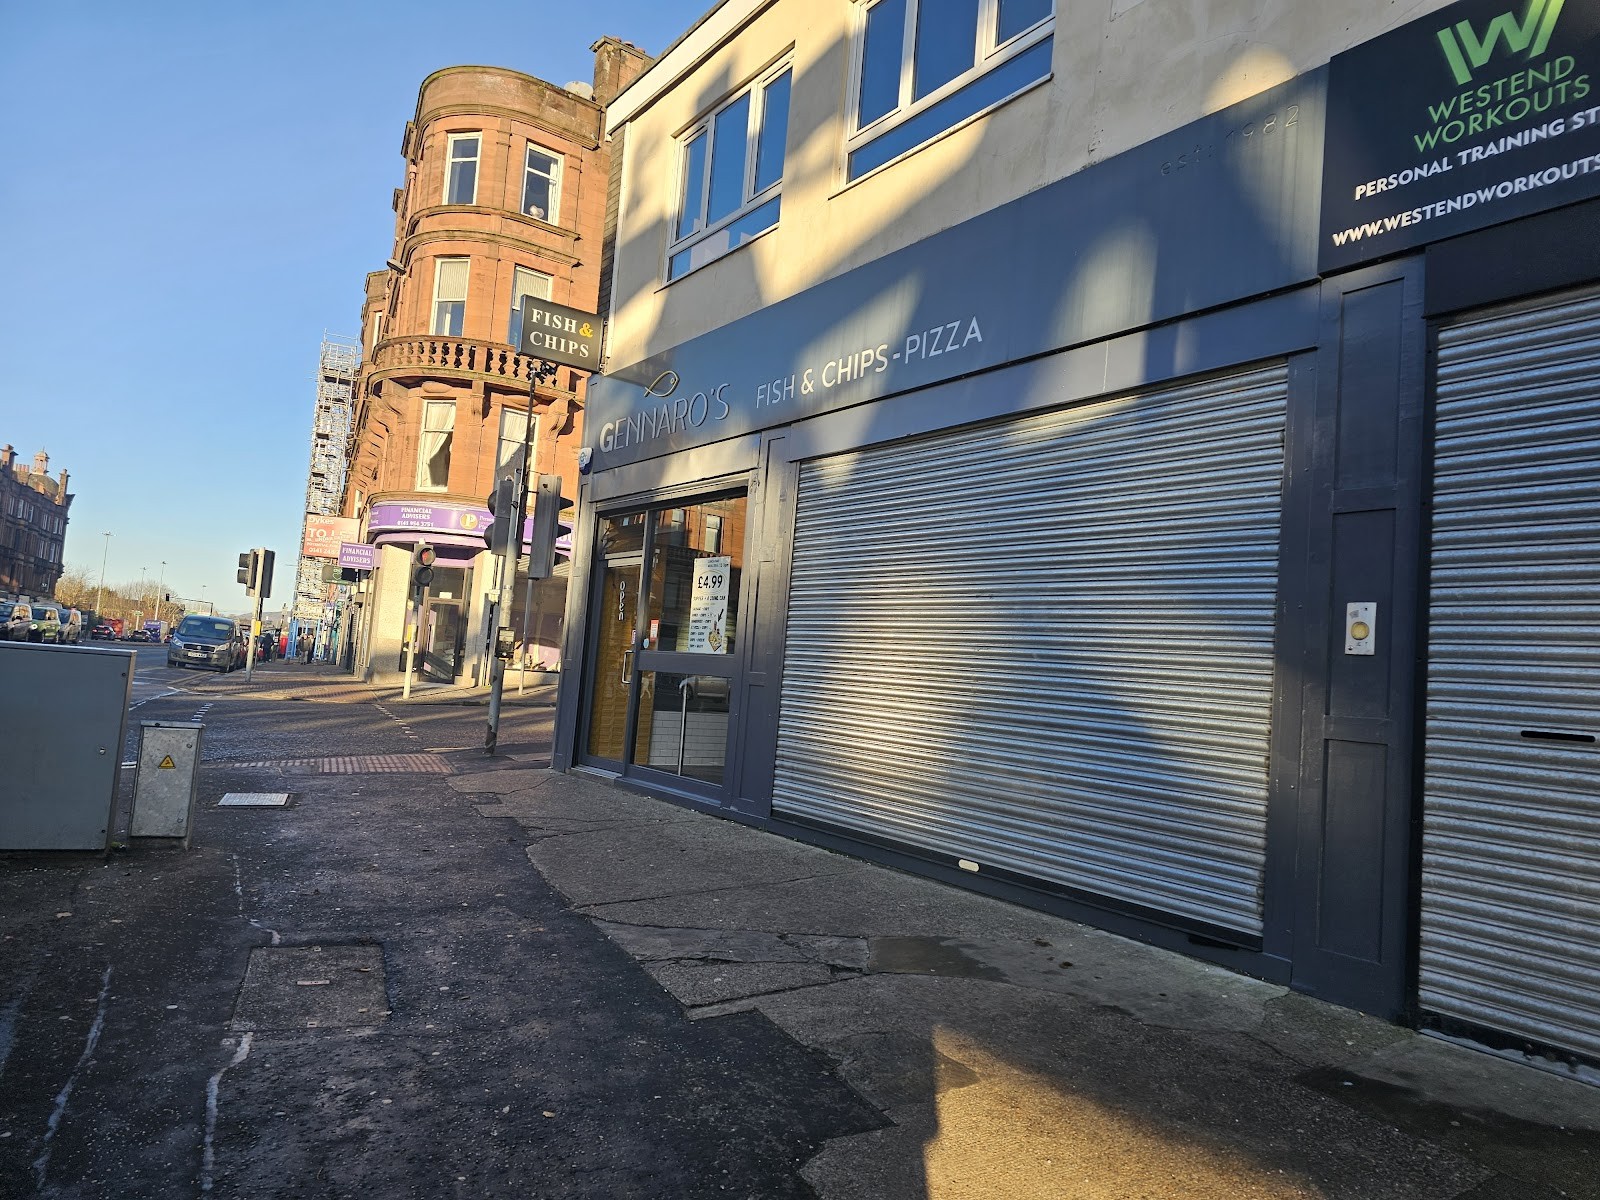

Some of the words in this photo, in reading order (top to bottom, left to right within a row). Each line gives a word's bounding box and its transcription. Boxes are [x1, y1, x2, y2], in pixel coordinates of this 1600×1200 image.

[1428, 55, 1576, 124] WESTEND
[1413, 74, 1591, 153] WORKOUTS
[1355, 157, 1453, 201] PERSONAL
[1457, 118, 1565, 167] TRAINING
[531, 308, 578, 334] FISH
[529, 331, 589, 358] CHIPS
[599, 383, 731, 453] GENNARO'S
[756, 374, 796, 409] FISH
[800, 368, 815, 395] &
[905, 316, 983, 364] PIZZA
[308, 528, 327, 538] TO
[342, 547, 373, 557] FINANCIAL
[342, 555, 371, 564] ADVISERS
[697, 575, 723, 589] £4.99
[618, 580, 626, 621] open
